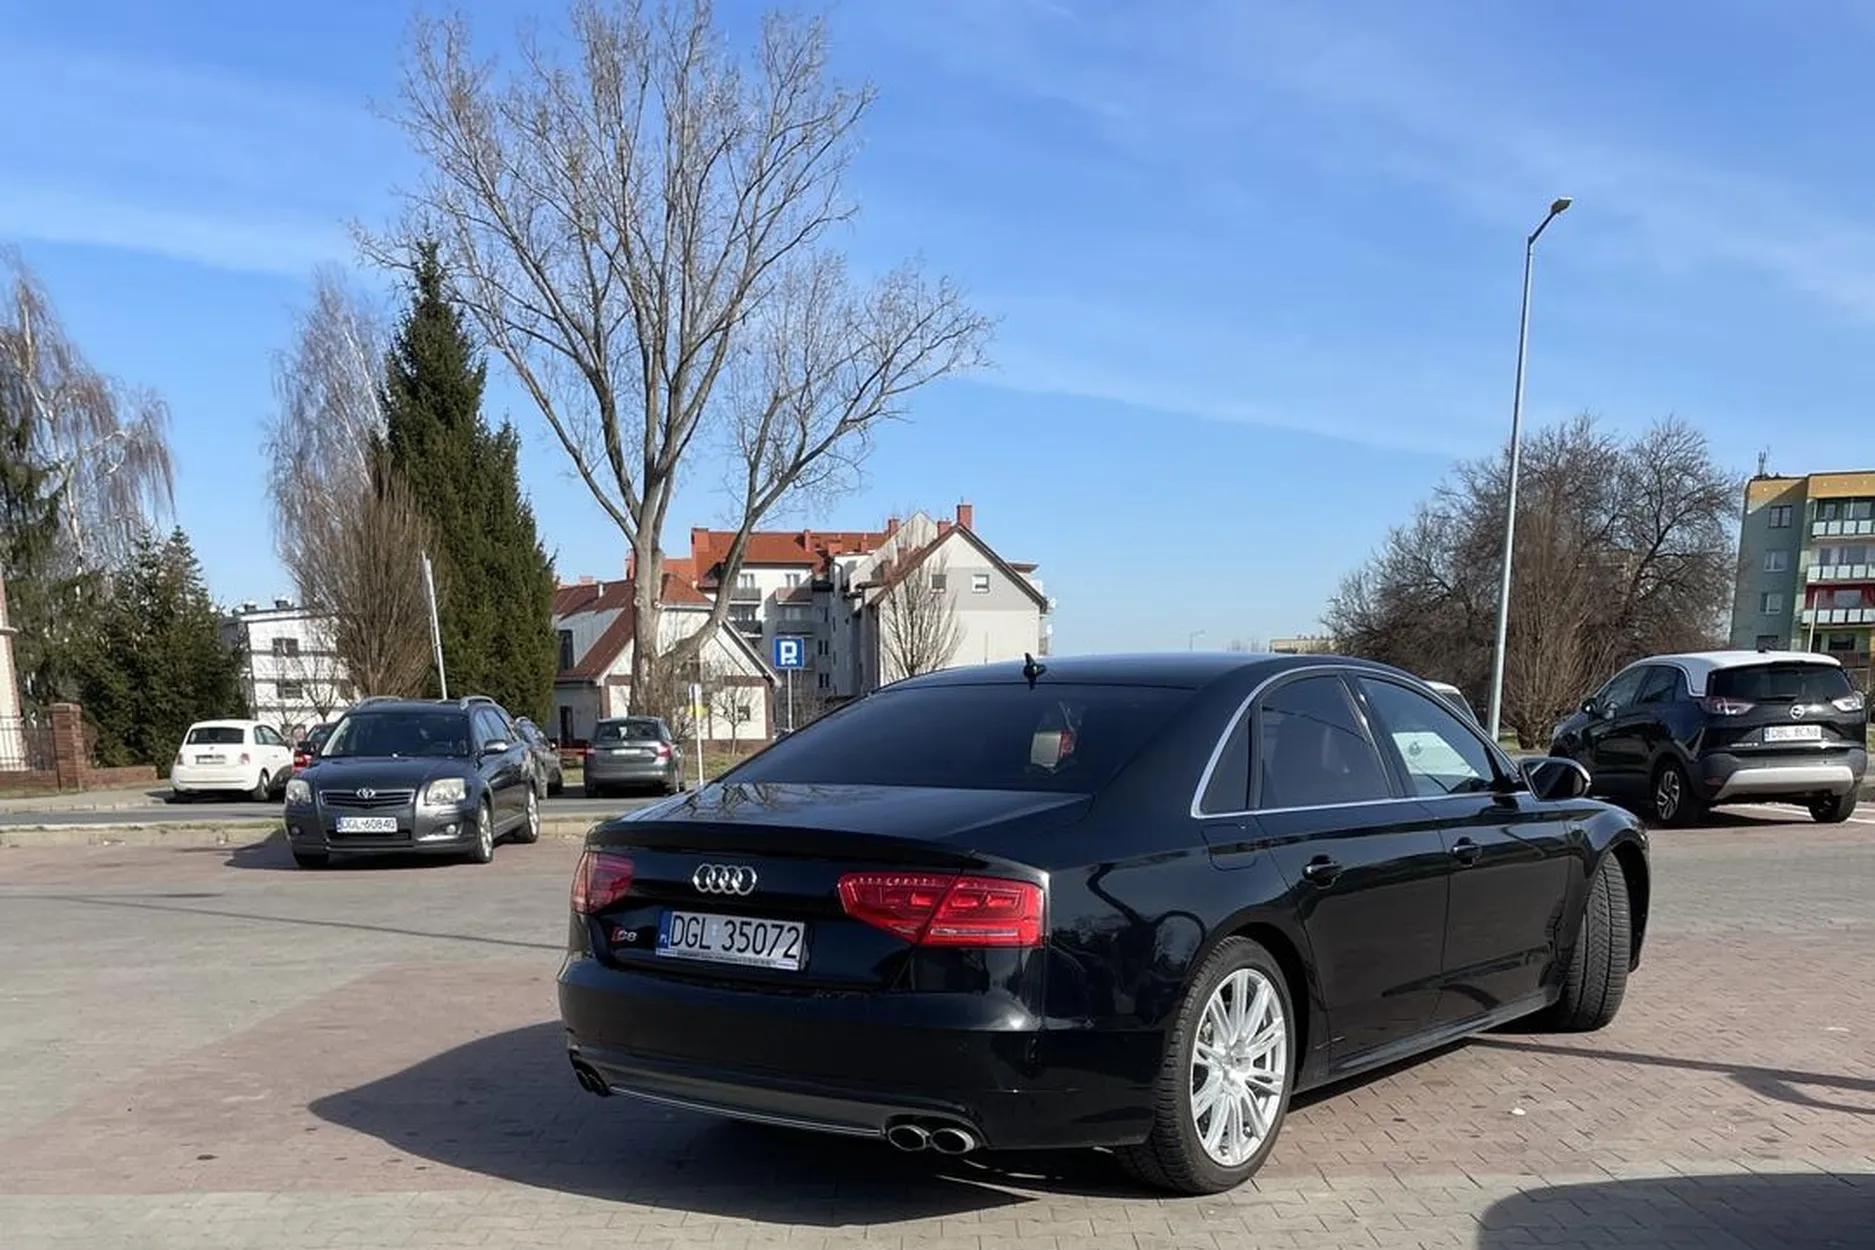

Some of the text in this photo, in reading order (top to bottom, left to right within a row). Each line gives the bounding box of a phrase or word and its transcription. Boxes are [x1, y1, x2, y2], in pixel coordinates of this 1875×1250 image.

[780, 641, 798, 665] P
[670, 914, 712, 951] DGL
[721, 918, 801, 960] 35072
